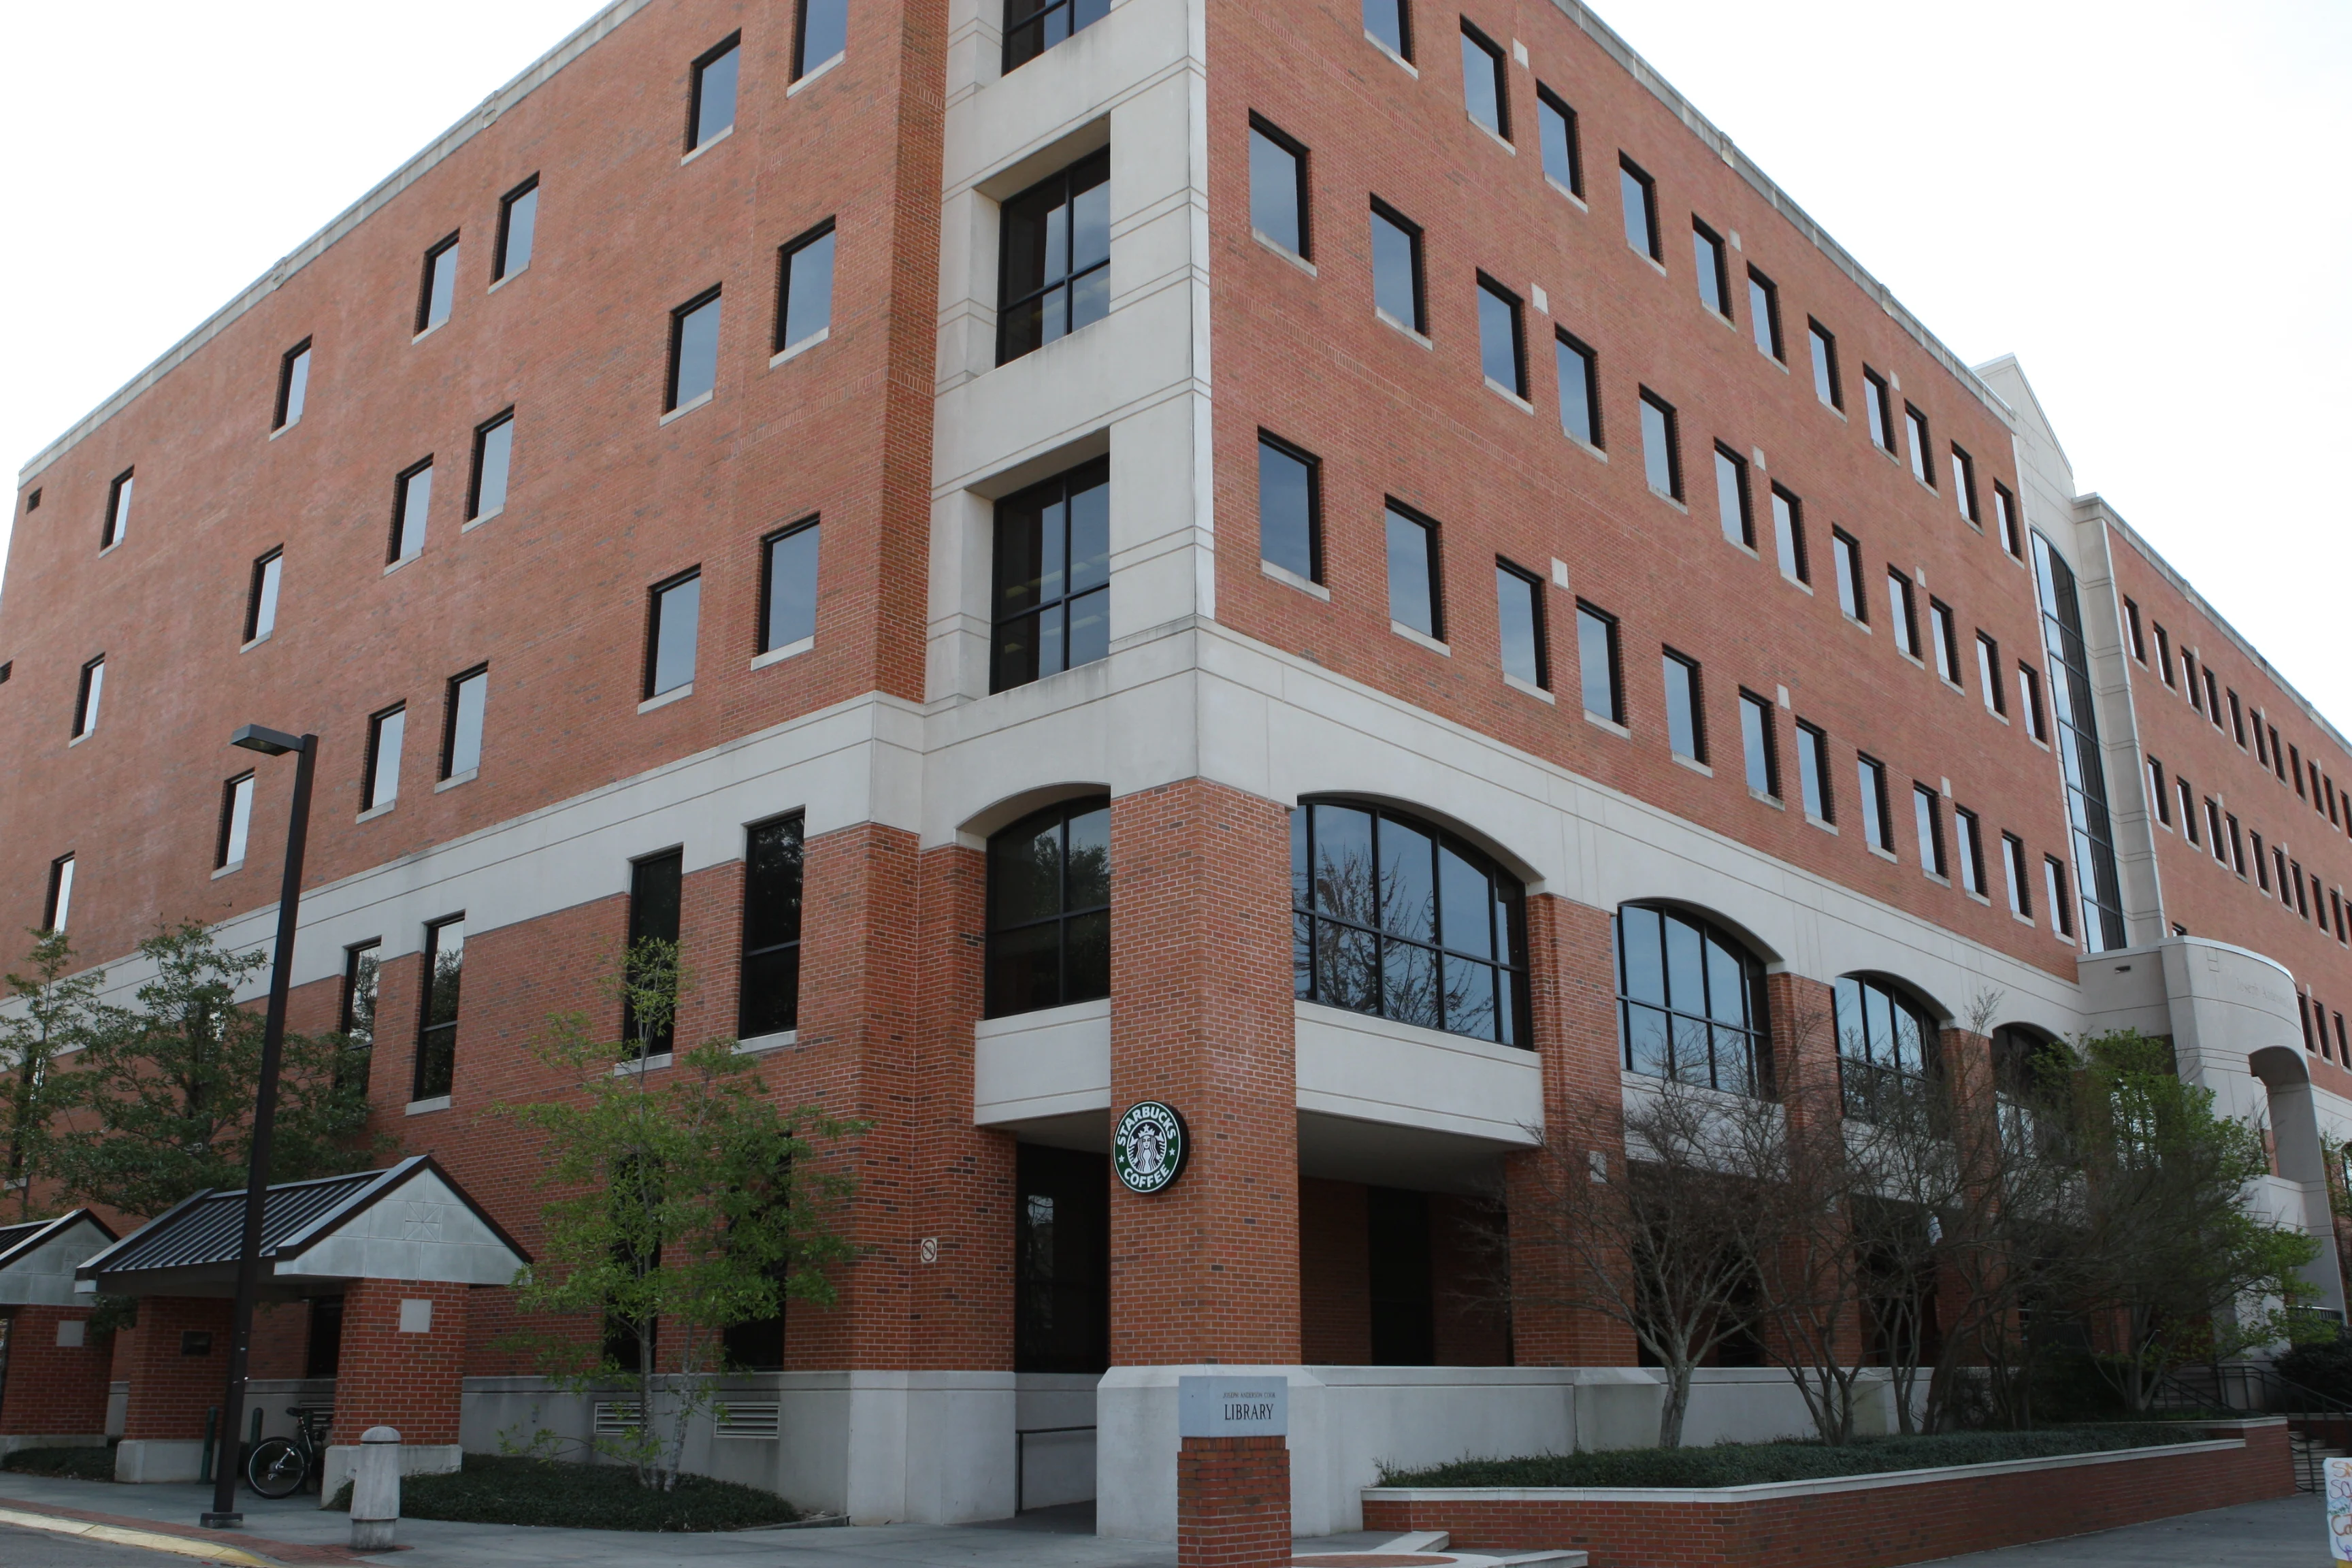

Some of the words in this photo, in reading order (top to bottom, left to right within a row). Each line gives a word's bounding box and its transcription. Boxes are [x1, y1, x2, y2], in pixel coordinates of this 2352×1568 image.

[1117, 1106, 1177, 1147] STARBUCKS
[1124, 1163, 1170, 1188] COFFEE
[1224, 1403, 1274, 1420] LIBRARY
